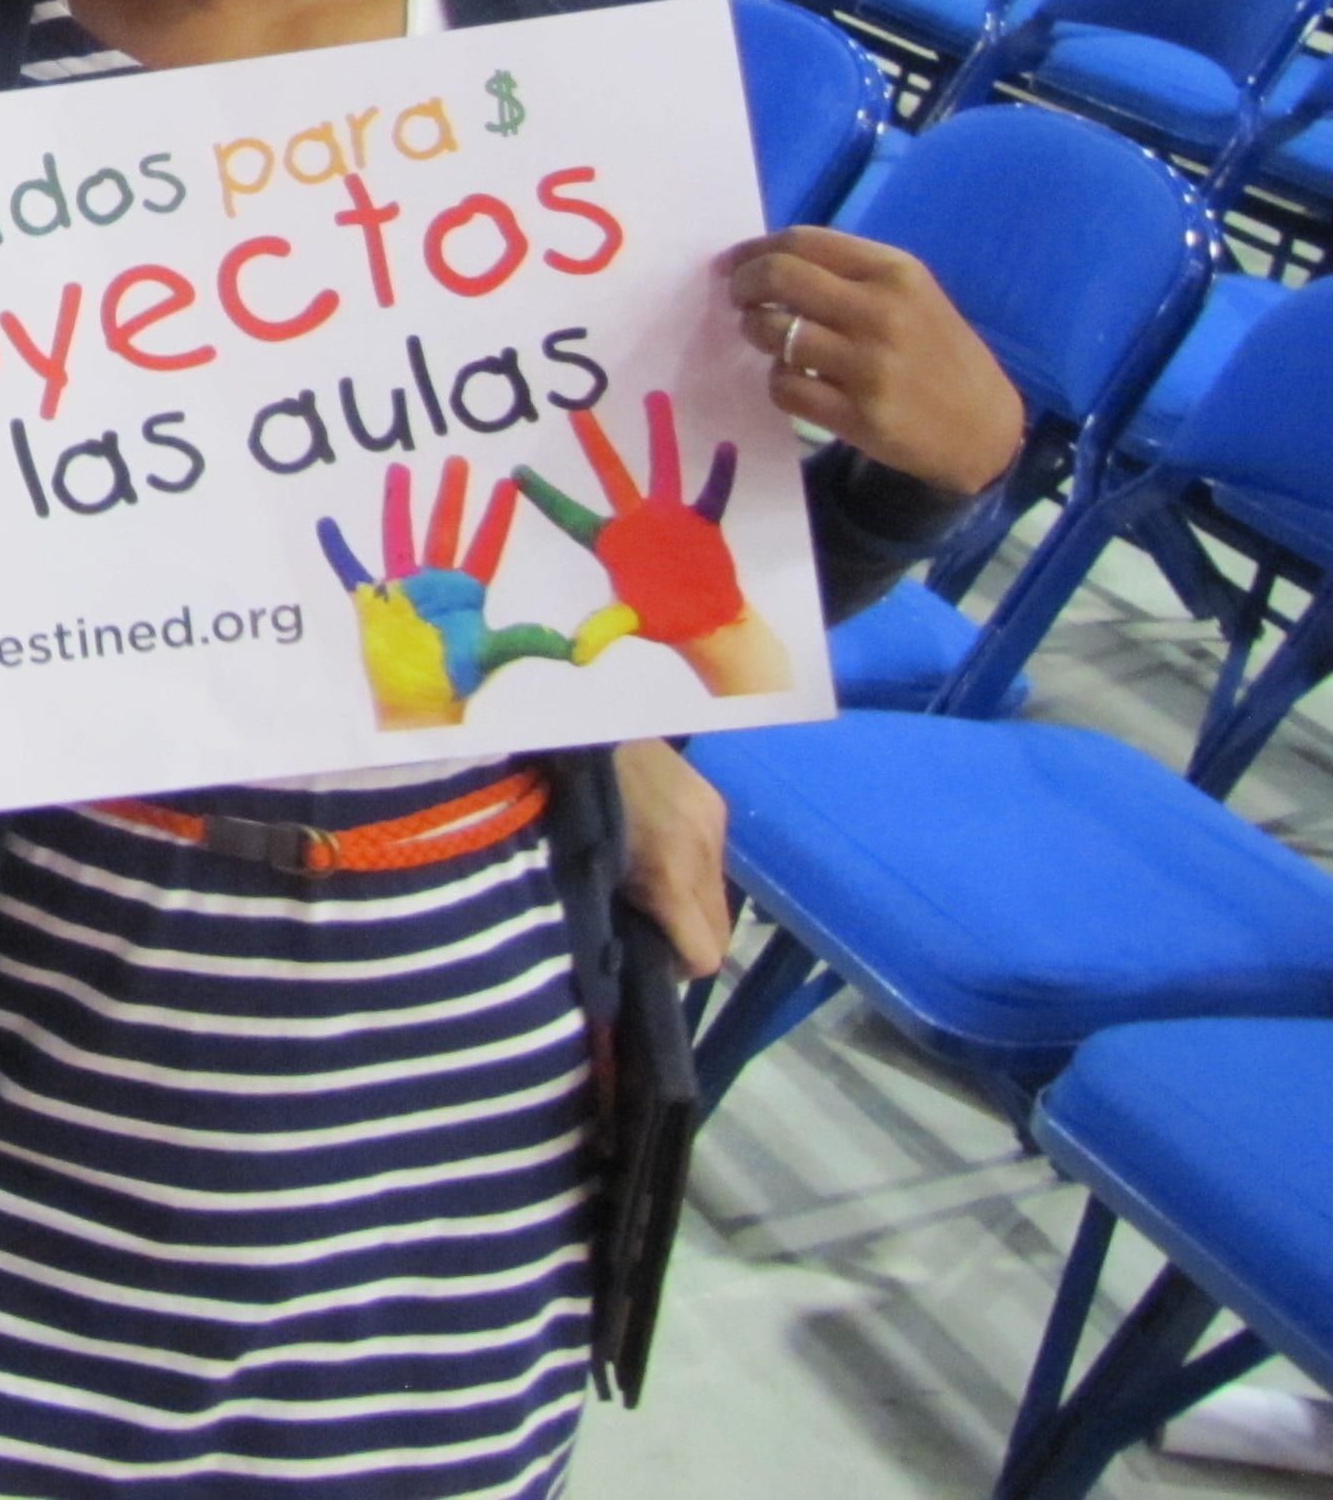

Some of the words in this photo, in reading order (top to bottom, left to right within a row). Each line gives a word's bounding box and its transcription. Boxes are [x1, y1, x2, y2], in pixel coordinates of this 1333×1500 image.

[212, 95, 458, 217] para
[10, 409, 205, 519] las
[246, 327, 610, 475] aulas
